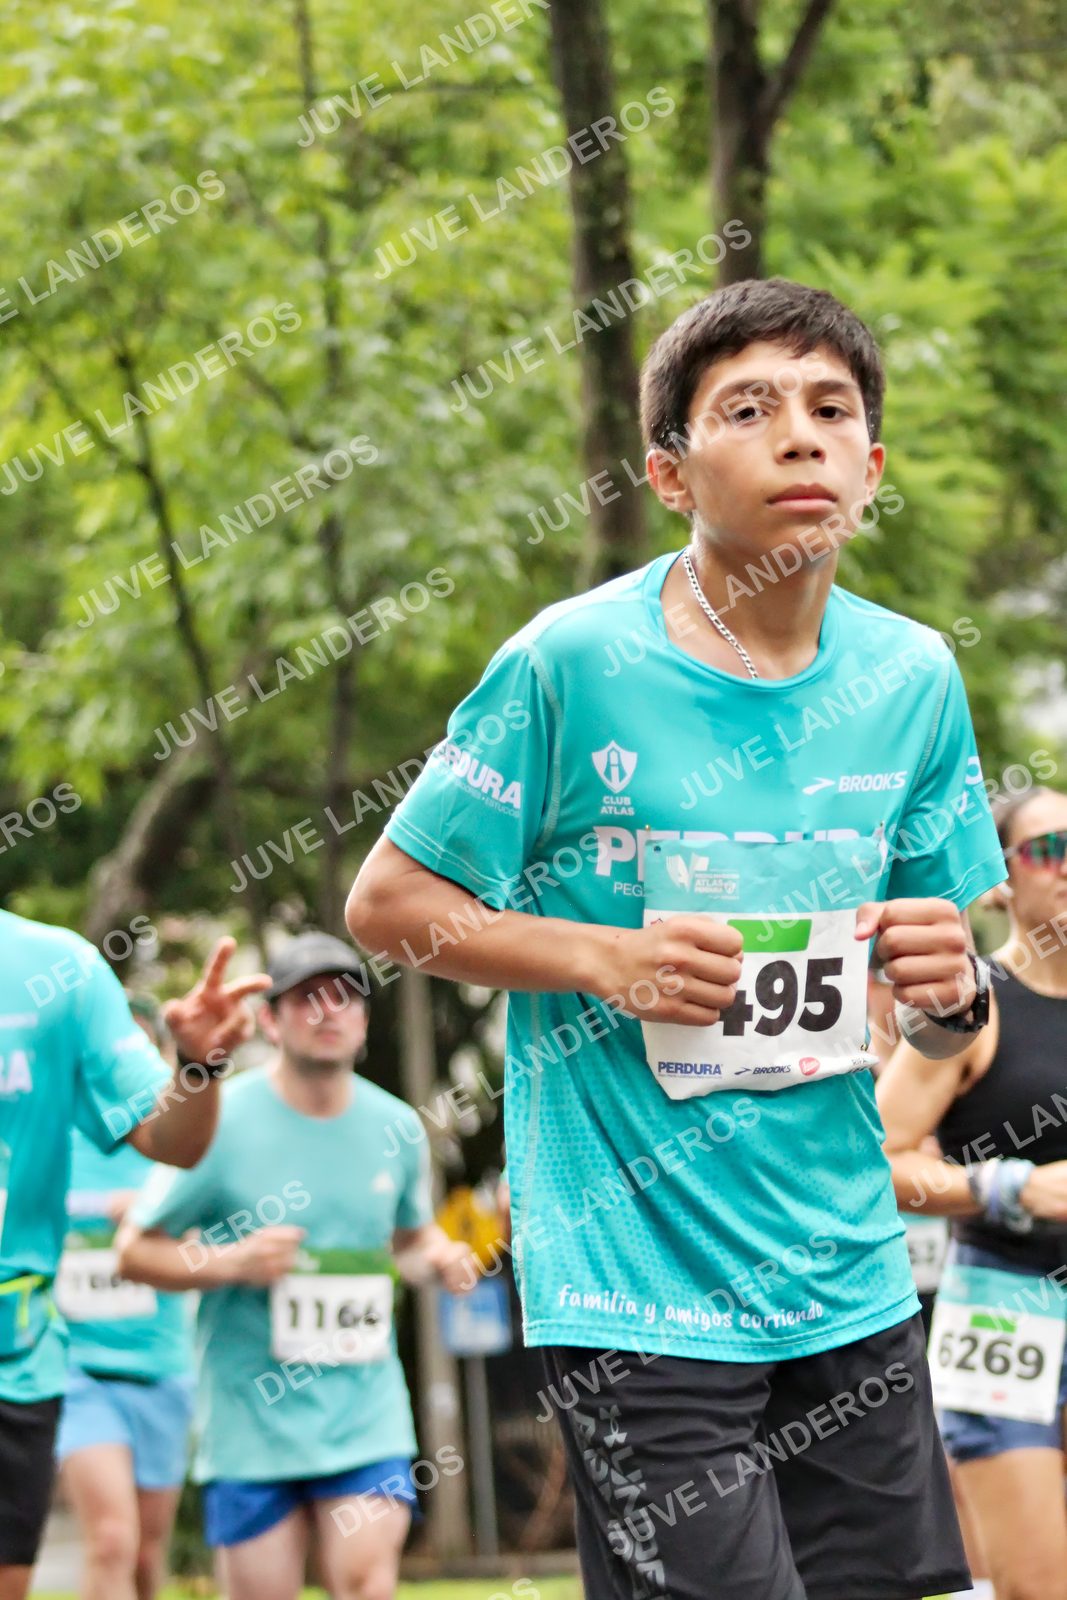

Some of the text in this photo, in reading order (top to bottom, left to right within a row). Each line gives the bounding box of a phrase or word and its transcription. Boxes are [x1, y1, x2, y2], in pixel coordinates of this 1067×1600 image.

[838, 770, 908, 793] BROOKS
[602, 796, 631, 805] CLUB
[600, 806, 635, 816] ATLAS
[658, 1062, 722, 1075] PERDURA
[752, 1064, 791, 1075] BROOKS
[558, 1284, 823, 1331] familia y amigos corriendo
[938, 1332, 1045, 1381] 6269
